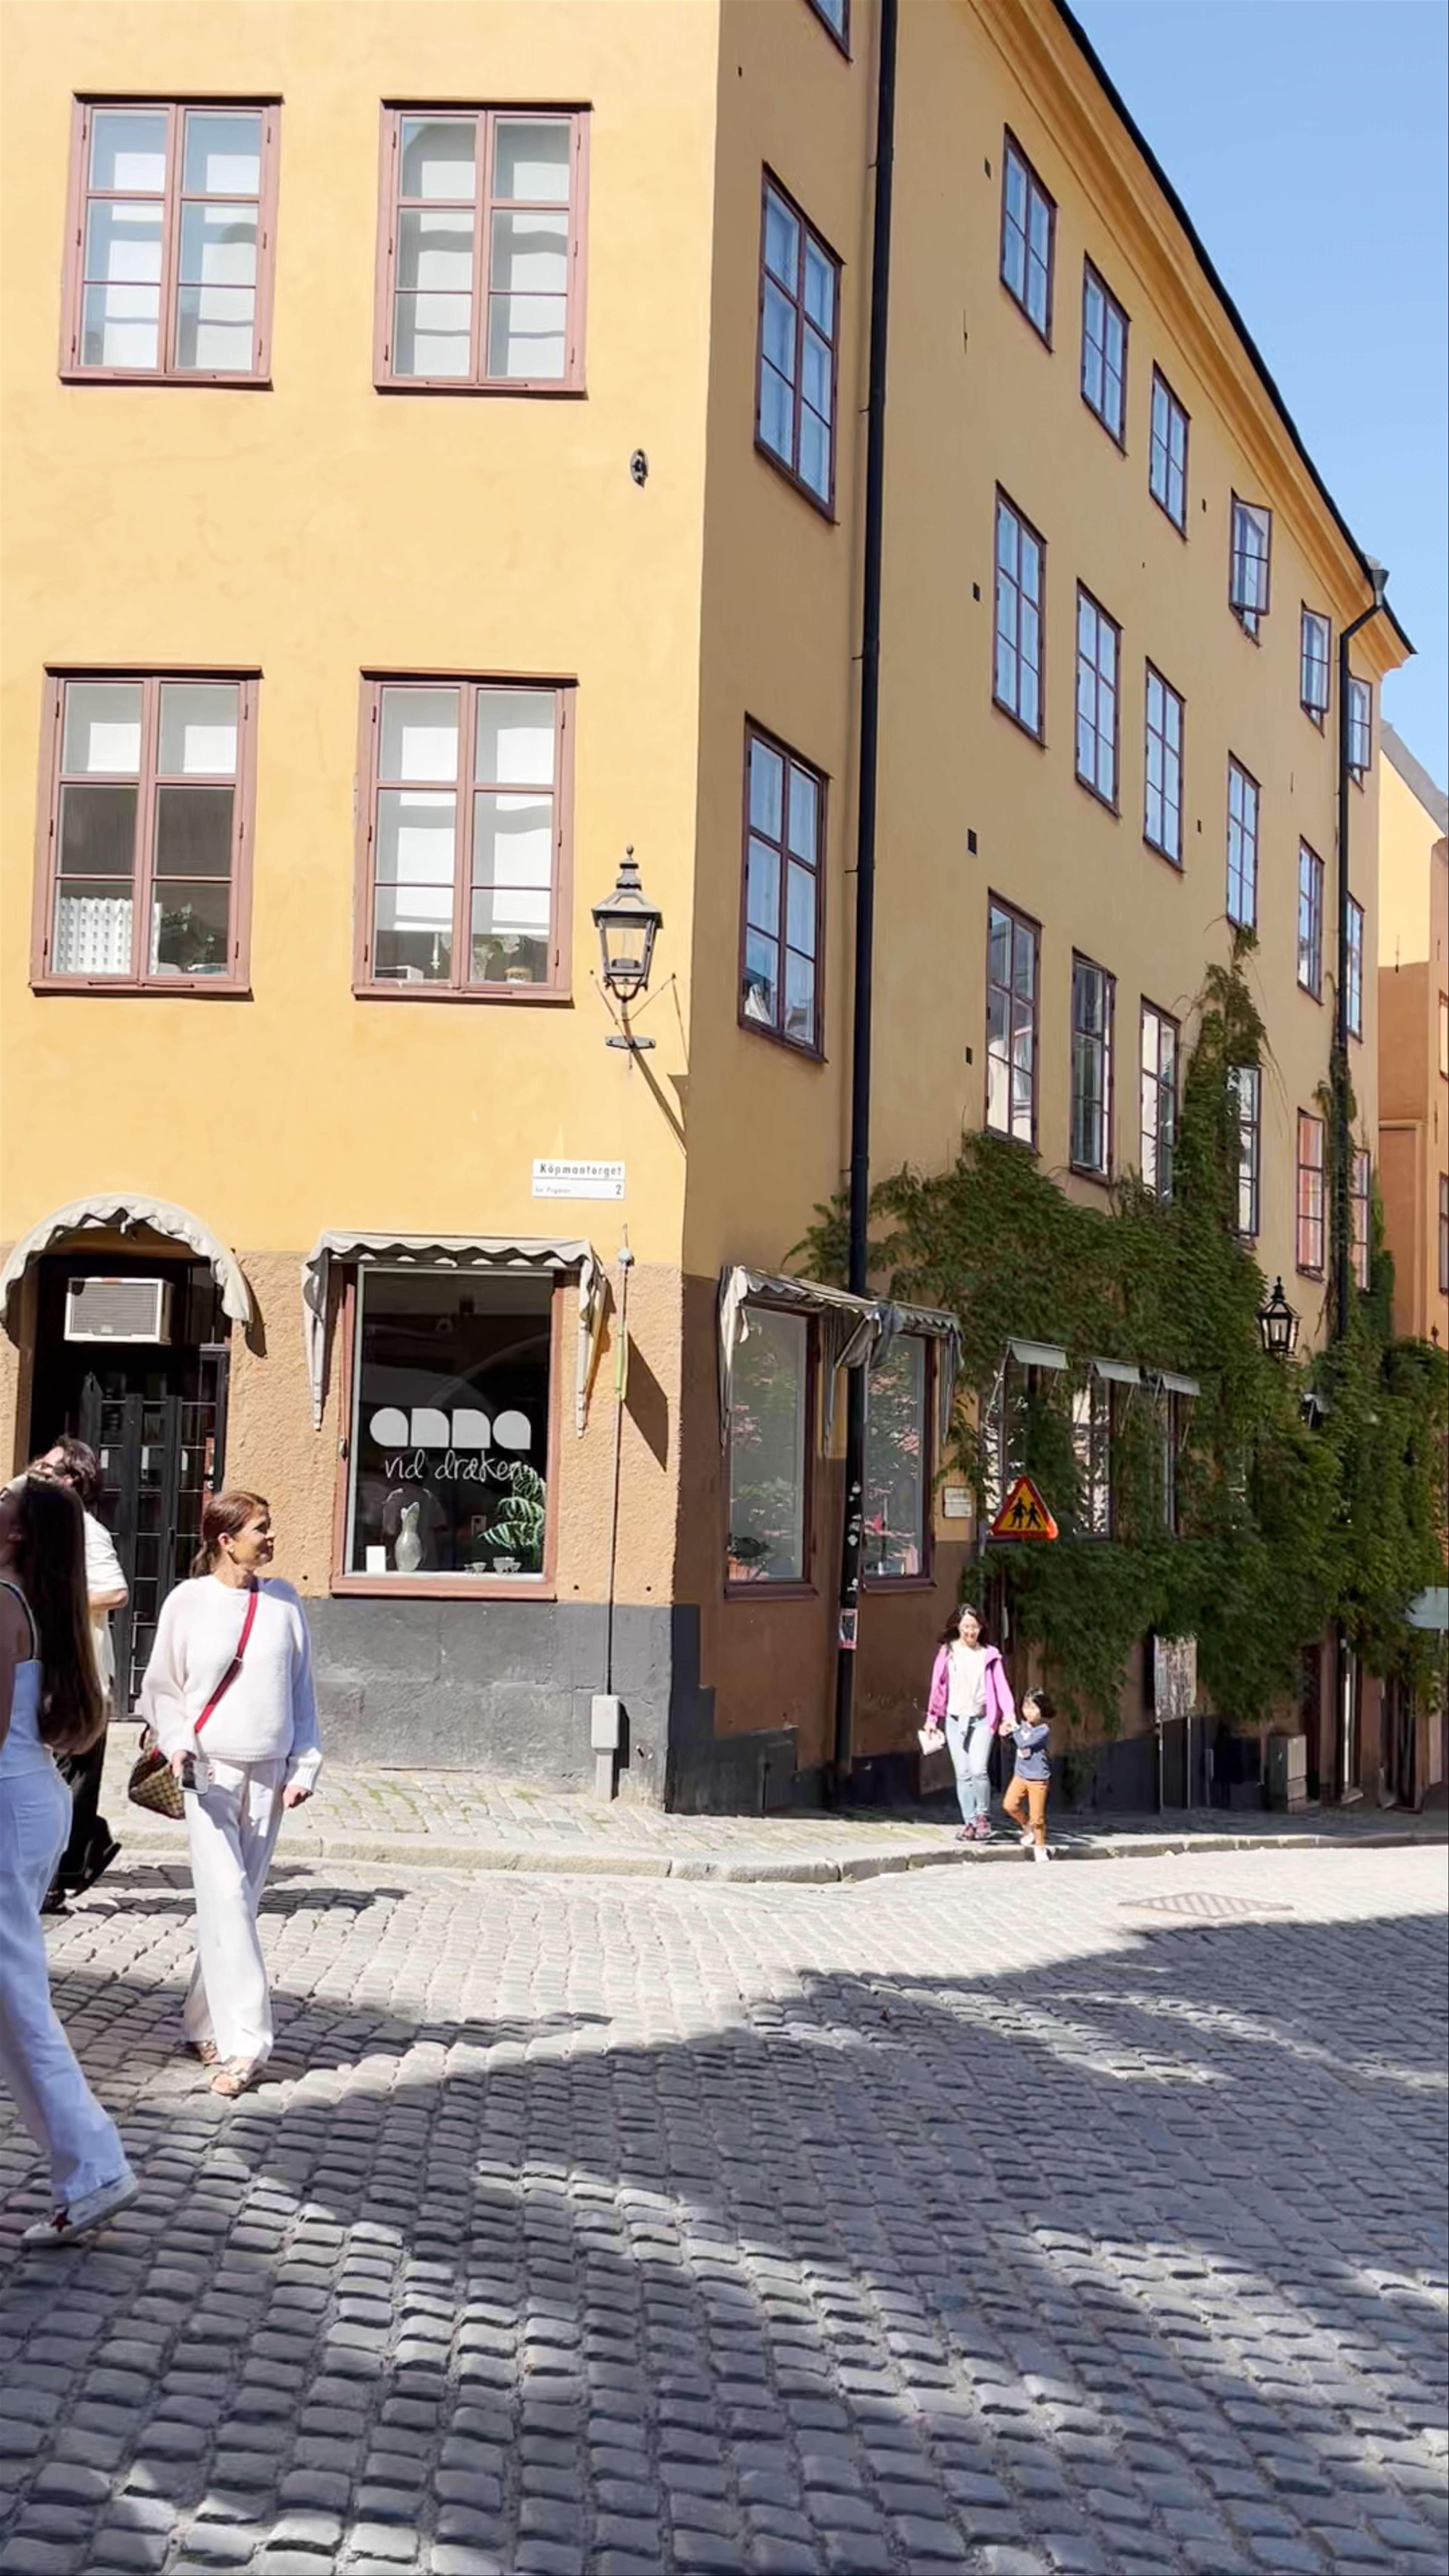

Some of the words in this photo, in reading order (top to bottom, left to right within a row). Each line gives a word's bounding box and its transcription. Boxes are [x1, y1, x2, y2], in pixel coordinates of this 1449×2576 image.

[540, 1163, 621, 1178] Köpmantorget
[616, 1184, 621, 1195] 2
[369, 1407, 531, 1450] anna
[385, 1449, 425, 1479] vid
[434, 1450, 523, 1482] draken
